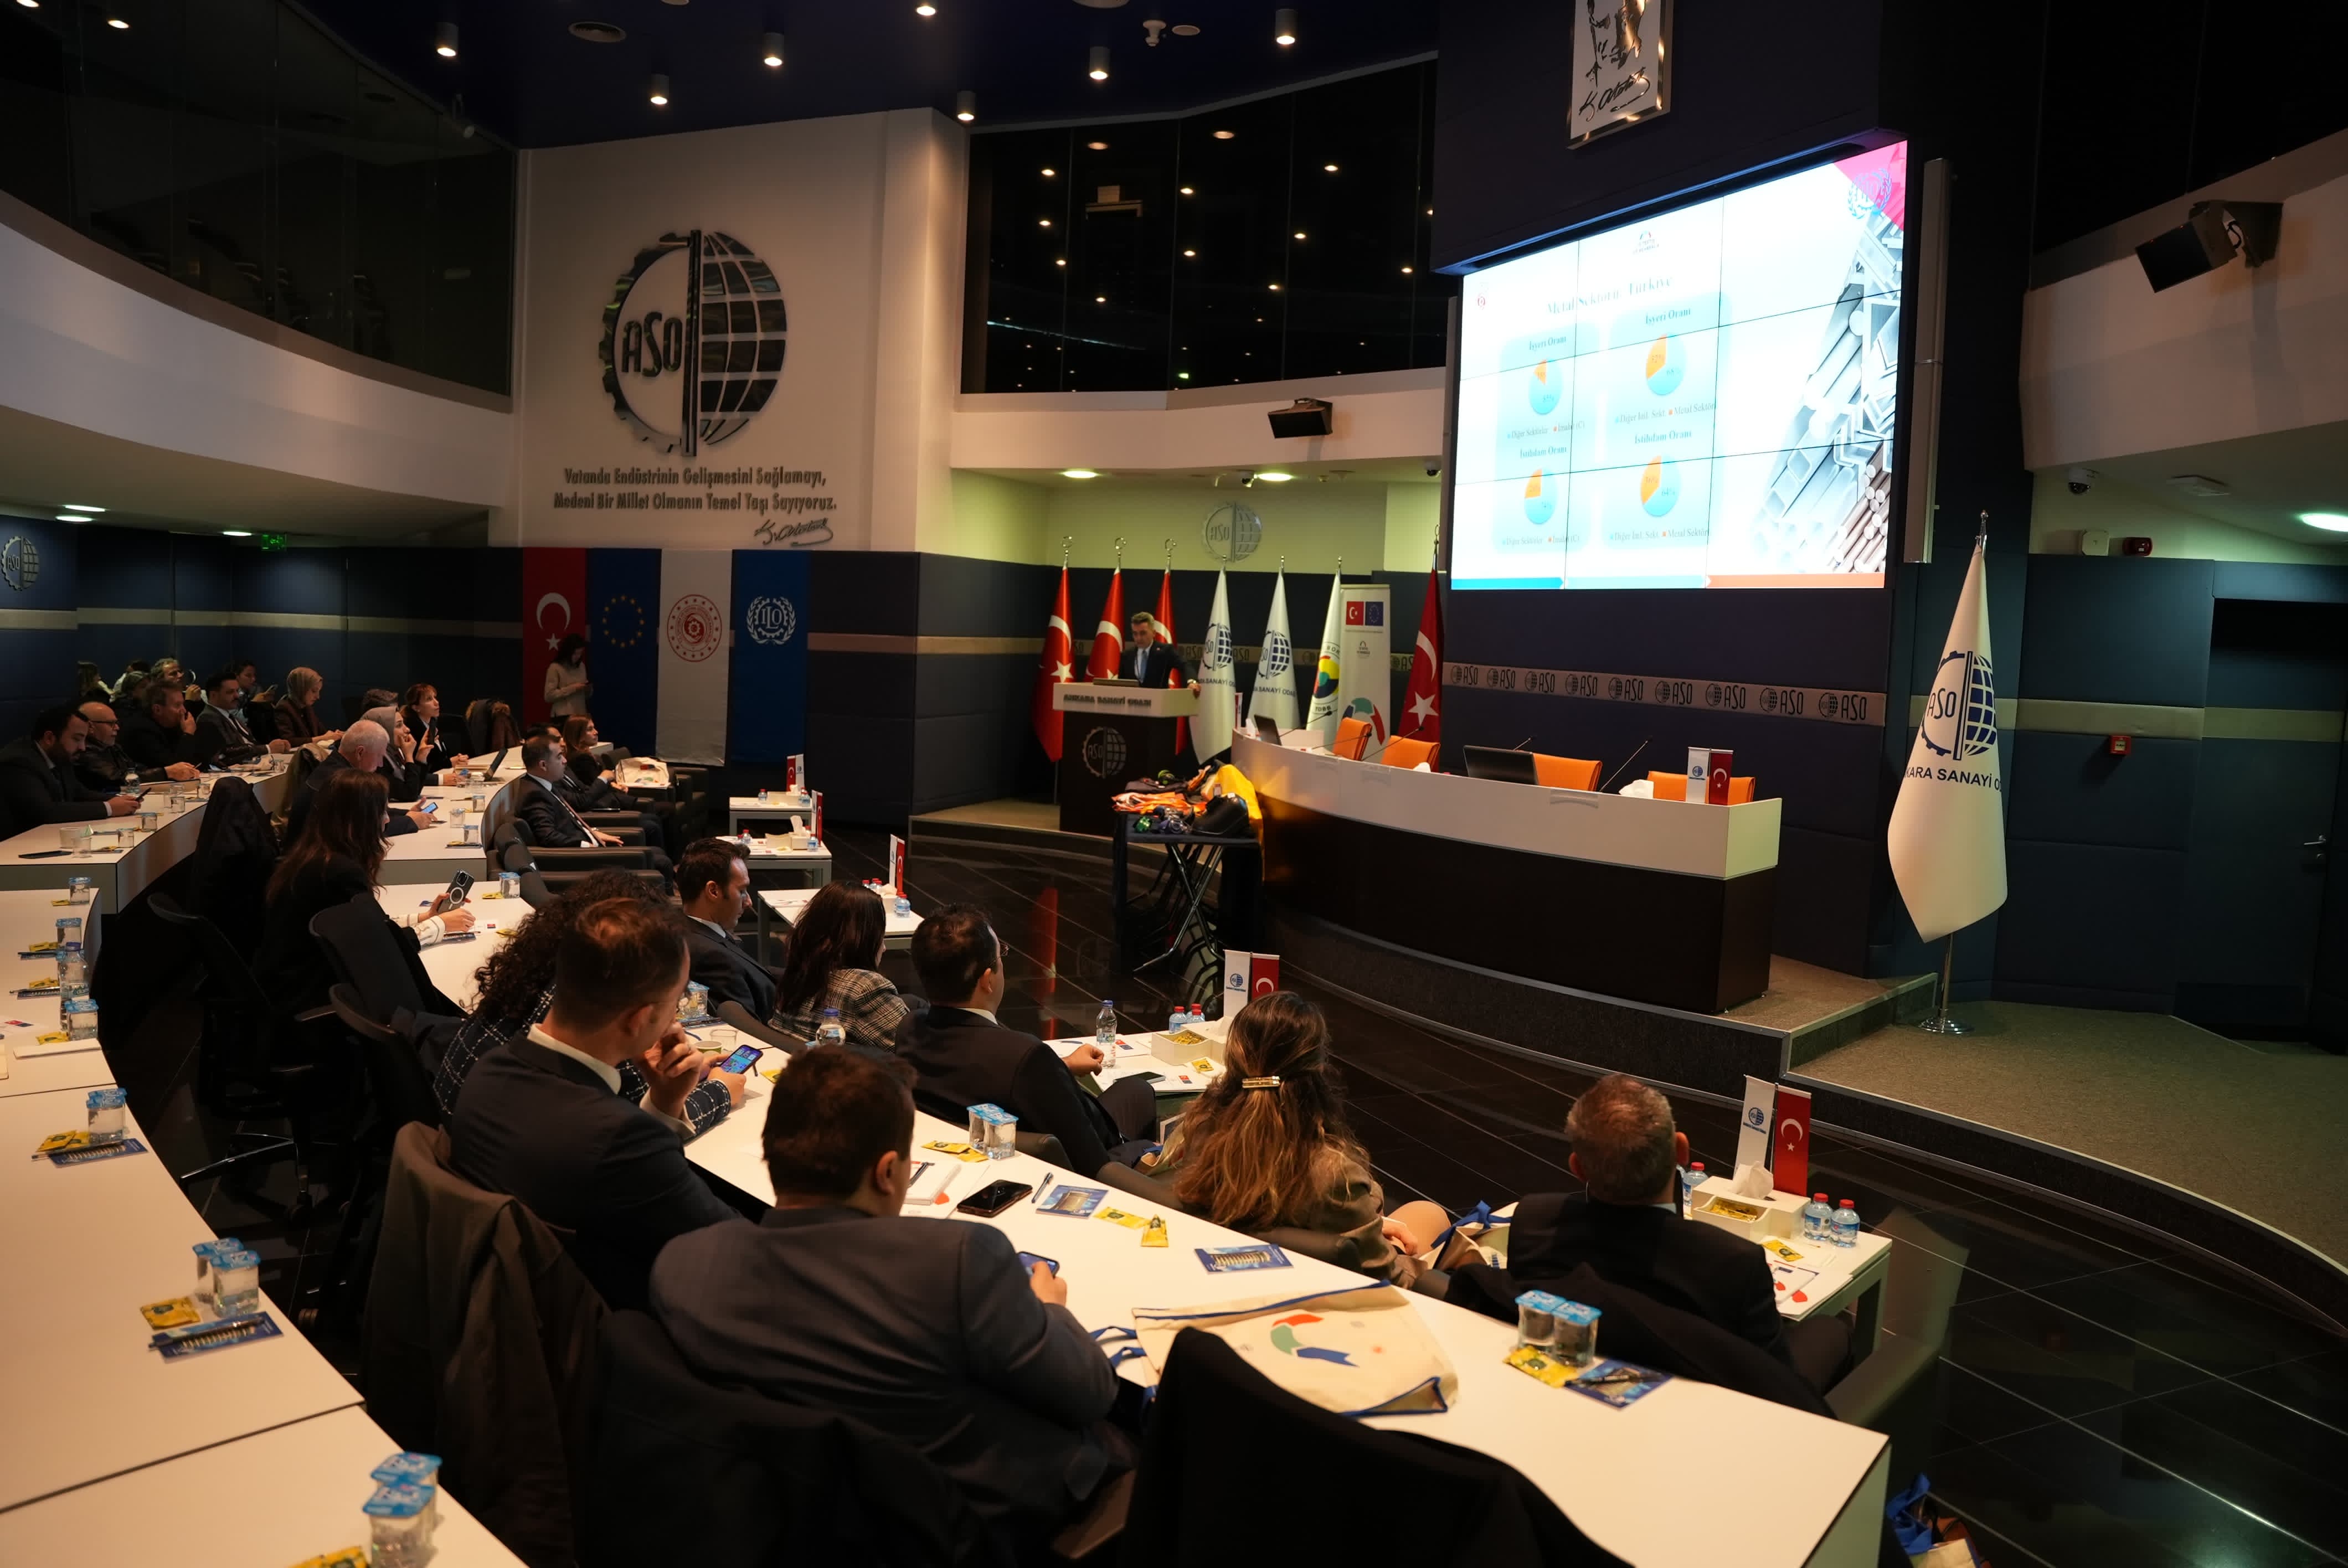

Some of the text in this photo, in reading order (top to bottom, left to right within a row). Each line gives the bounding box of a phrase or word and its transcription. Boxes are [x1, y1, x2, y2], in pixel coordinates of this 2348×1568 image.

[621, 312, 683, 377] ASO
[565, 467, 827, 489] Vatanda Endüstrinin Gelişmesini Sağlamayı,
[554, 492, 837, 516] Medeni Bir Millet Olmanın Temel Taşı Sayıyoruz.
[761, 606, 782, 629] ILO
[1401, 656, 1412, 670] AS
[1464, 666, 1478, 685] ASO
[1500, 669, 1516, 689] ASO
[1539, 672, 1555, 693] ASO
[1580, 675, 1598, 697] ASO
[1624, 678, 1643, 702] ASO
[1672, 682, 1692, 705] ASO
[1724, 685, 1746, 709] ASO
[1780, 689, 1804, 715] ASO
[1841, 694, 1867, 720] ASO
[1927, 688, 1956, 719] ASO
[1088, 744, 1103, 760] ASO
[1937, 768, 1992, 788] SANAYİ
